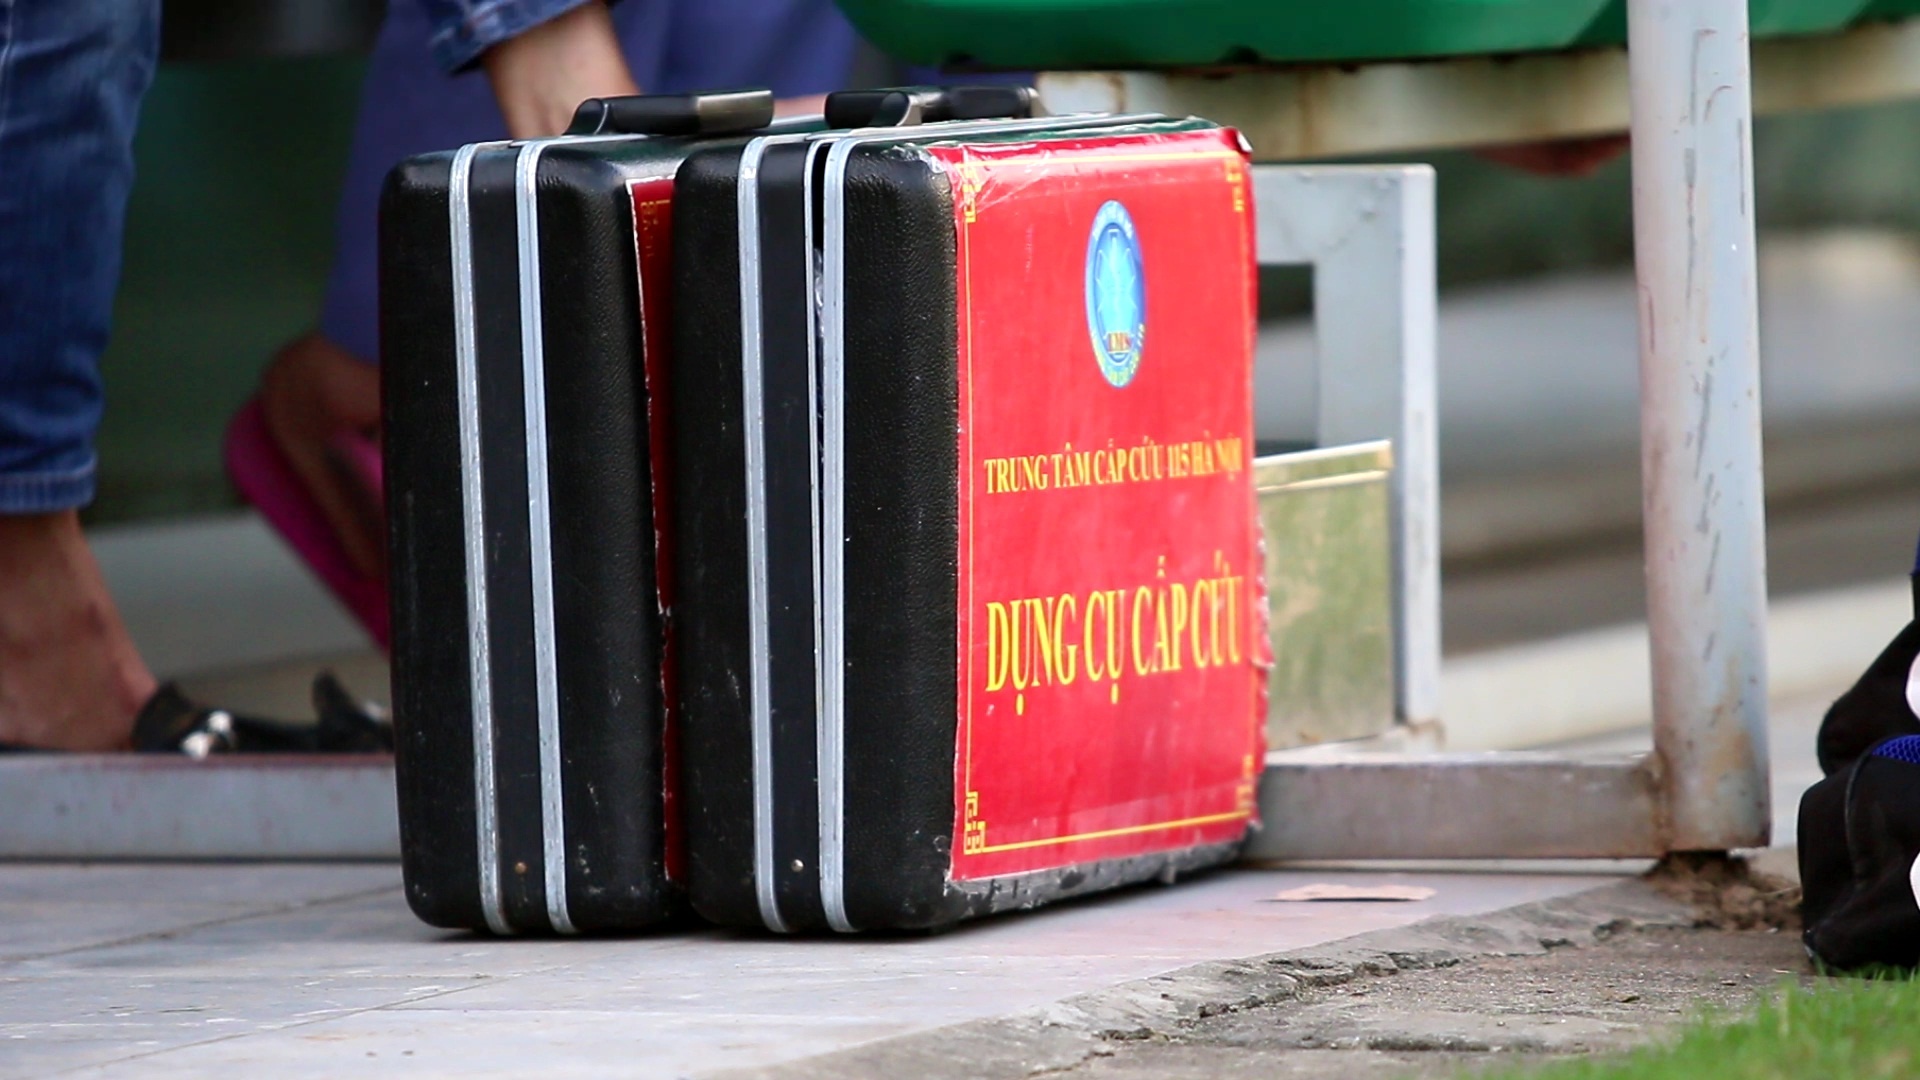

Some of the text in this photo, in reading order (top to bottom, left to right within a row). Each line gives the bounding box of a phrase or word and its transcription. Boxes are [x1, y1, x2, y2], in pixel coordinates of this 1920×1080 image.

[984, 454, 1048, 494] TRUNG
[1051, 442, 1091, 488] TÂM
[985, 549, 1243, 716] DỤNG CỤ CẤP CỨU
